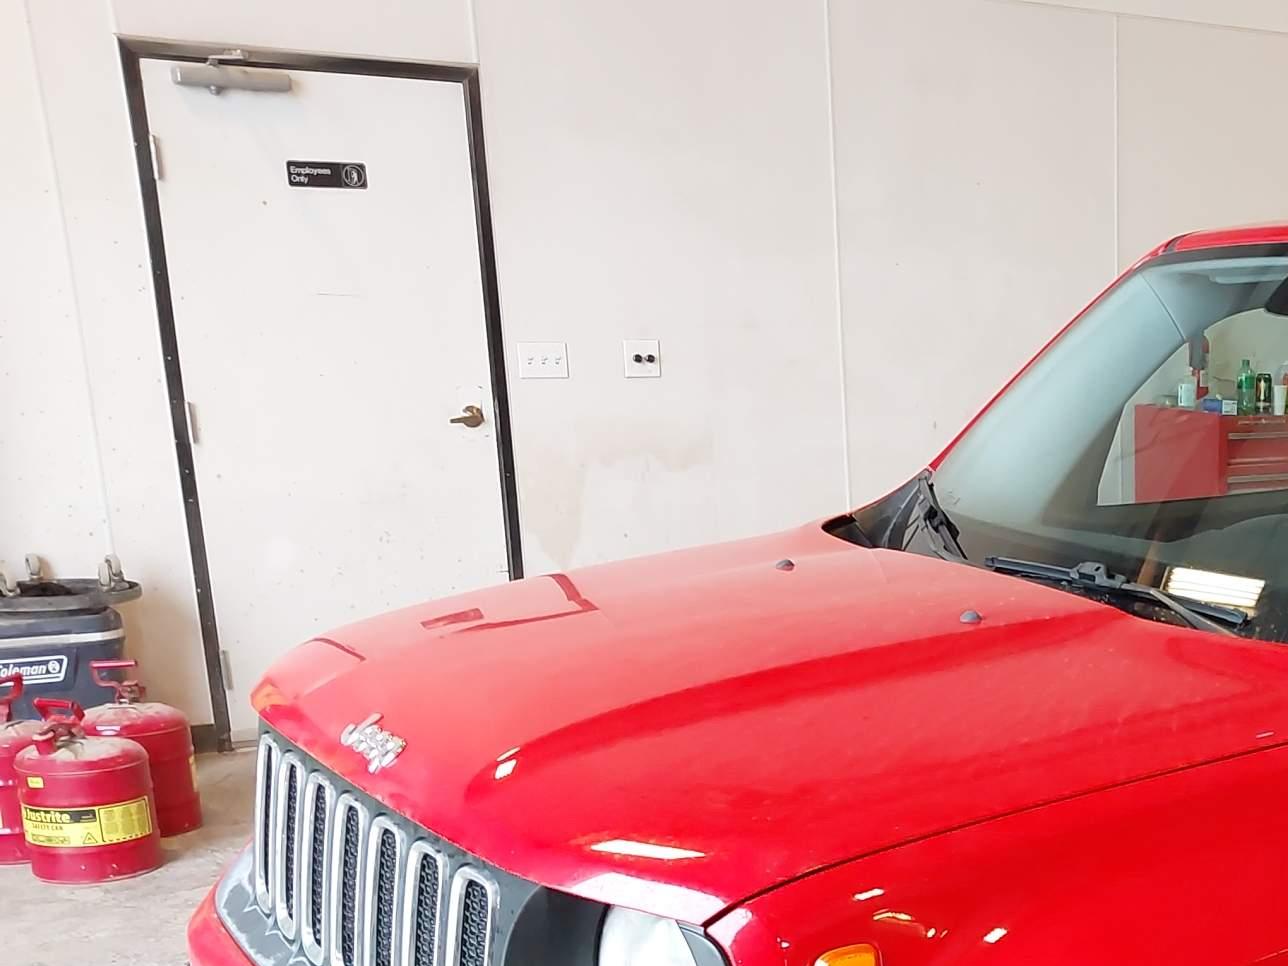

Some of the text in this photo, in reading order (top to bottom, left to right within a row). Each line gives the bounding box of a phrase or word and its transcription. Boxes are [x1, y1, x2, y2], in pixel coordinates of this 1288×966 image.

[289, 166, 331, 176] Employees
[290, 174, 309, 184] Only
[0, 663, 47, 678] oleman
[26, 808, 71, 823] Justrite
